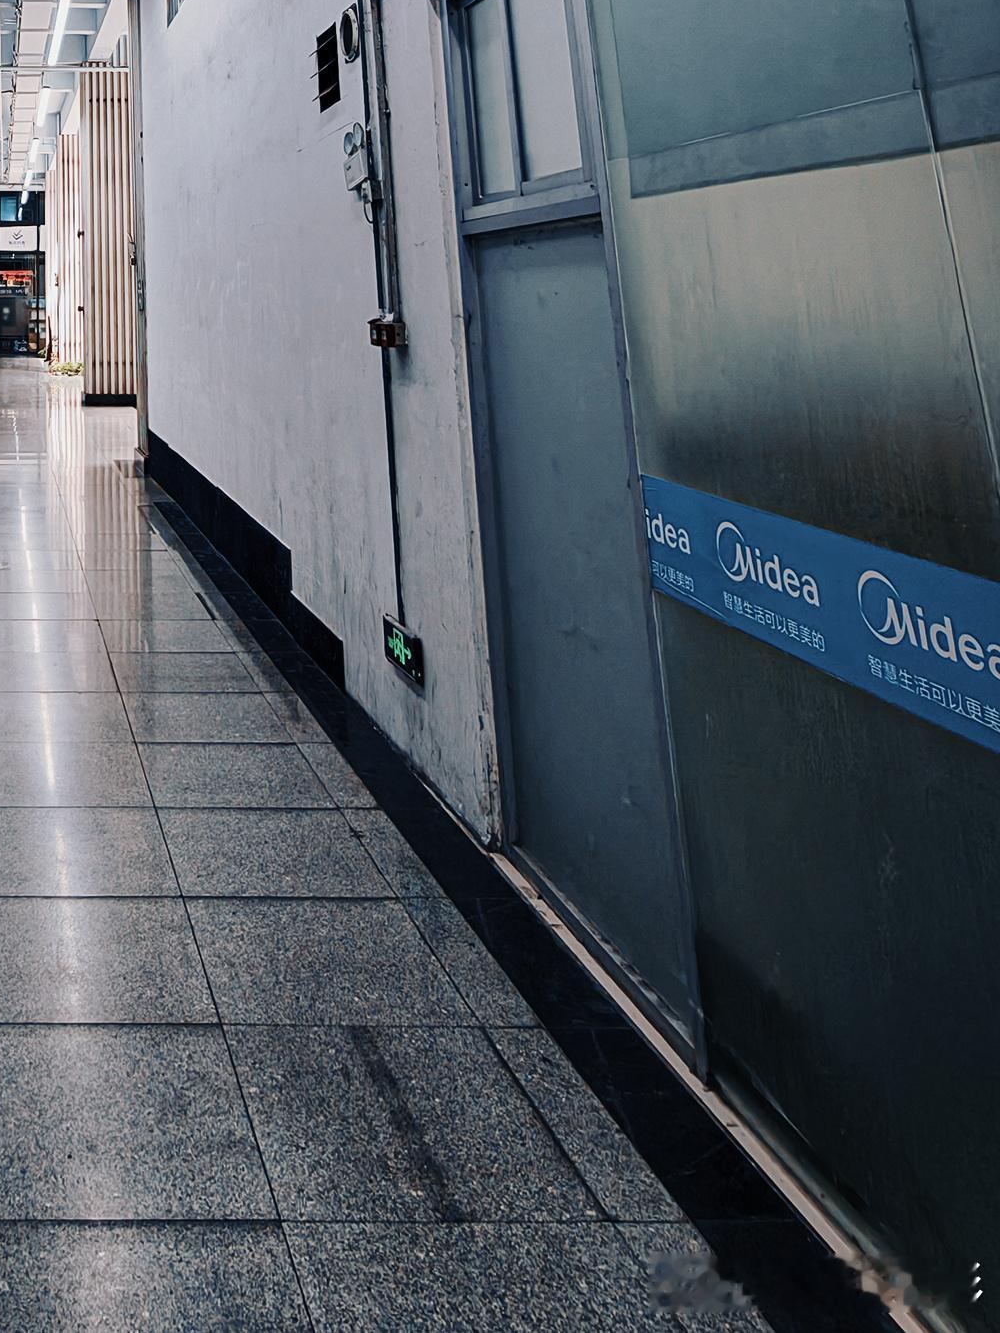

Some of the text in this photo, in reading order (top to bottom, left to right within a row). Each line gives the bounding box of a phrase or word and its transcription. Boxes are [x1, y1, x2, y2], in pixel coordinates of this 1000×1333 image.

[716, 521, 821, 607] Midea
[723, 591, 825, 652] 智慧生活可以更美的
